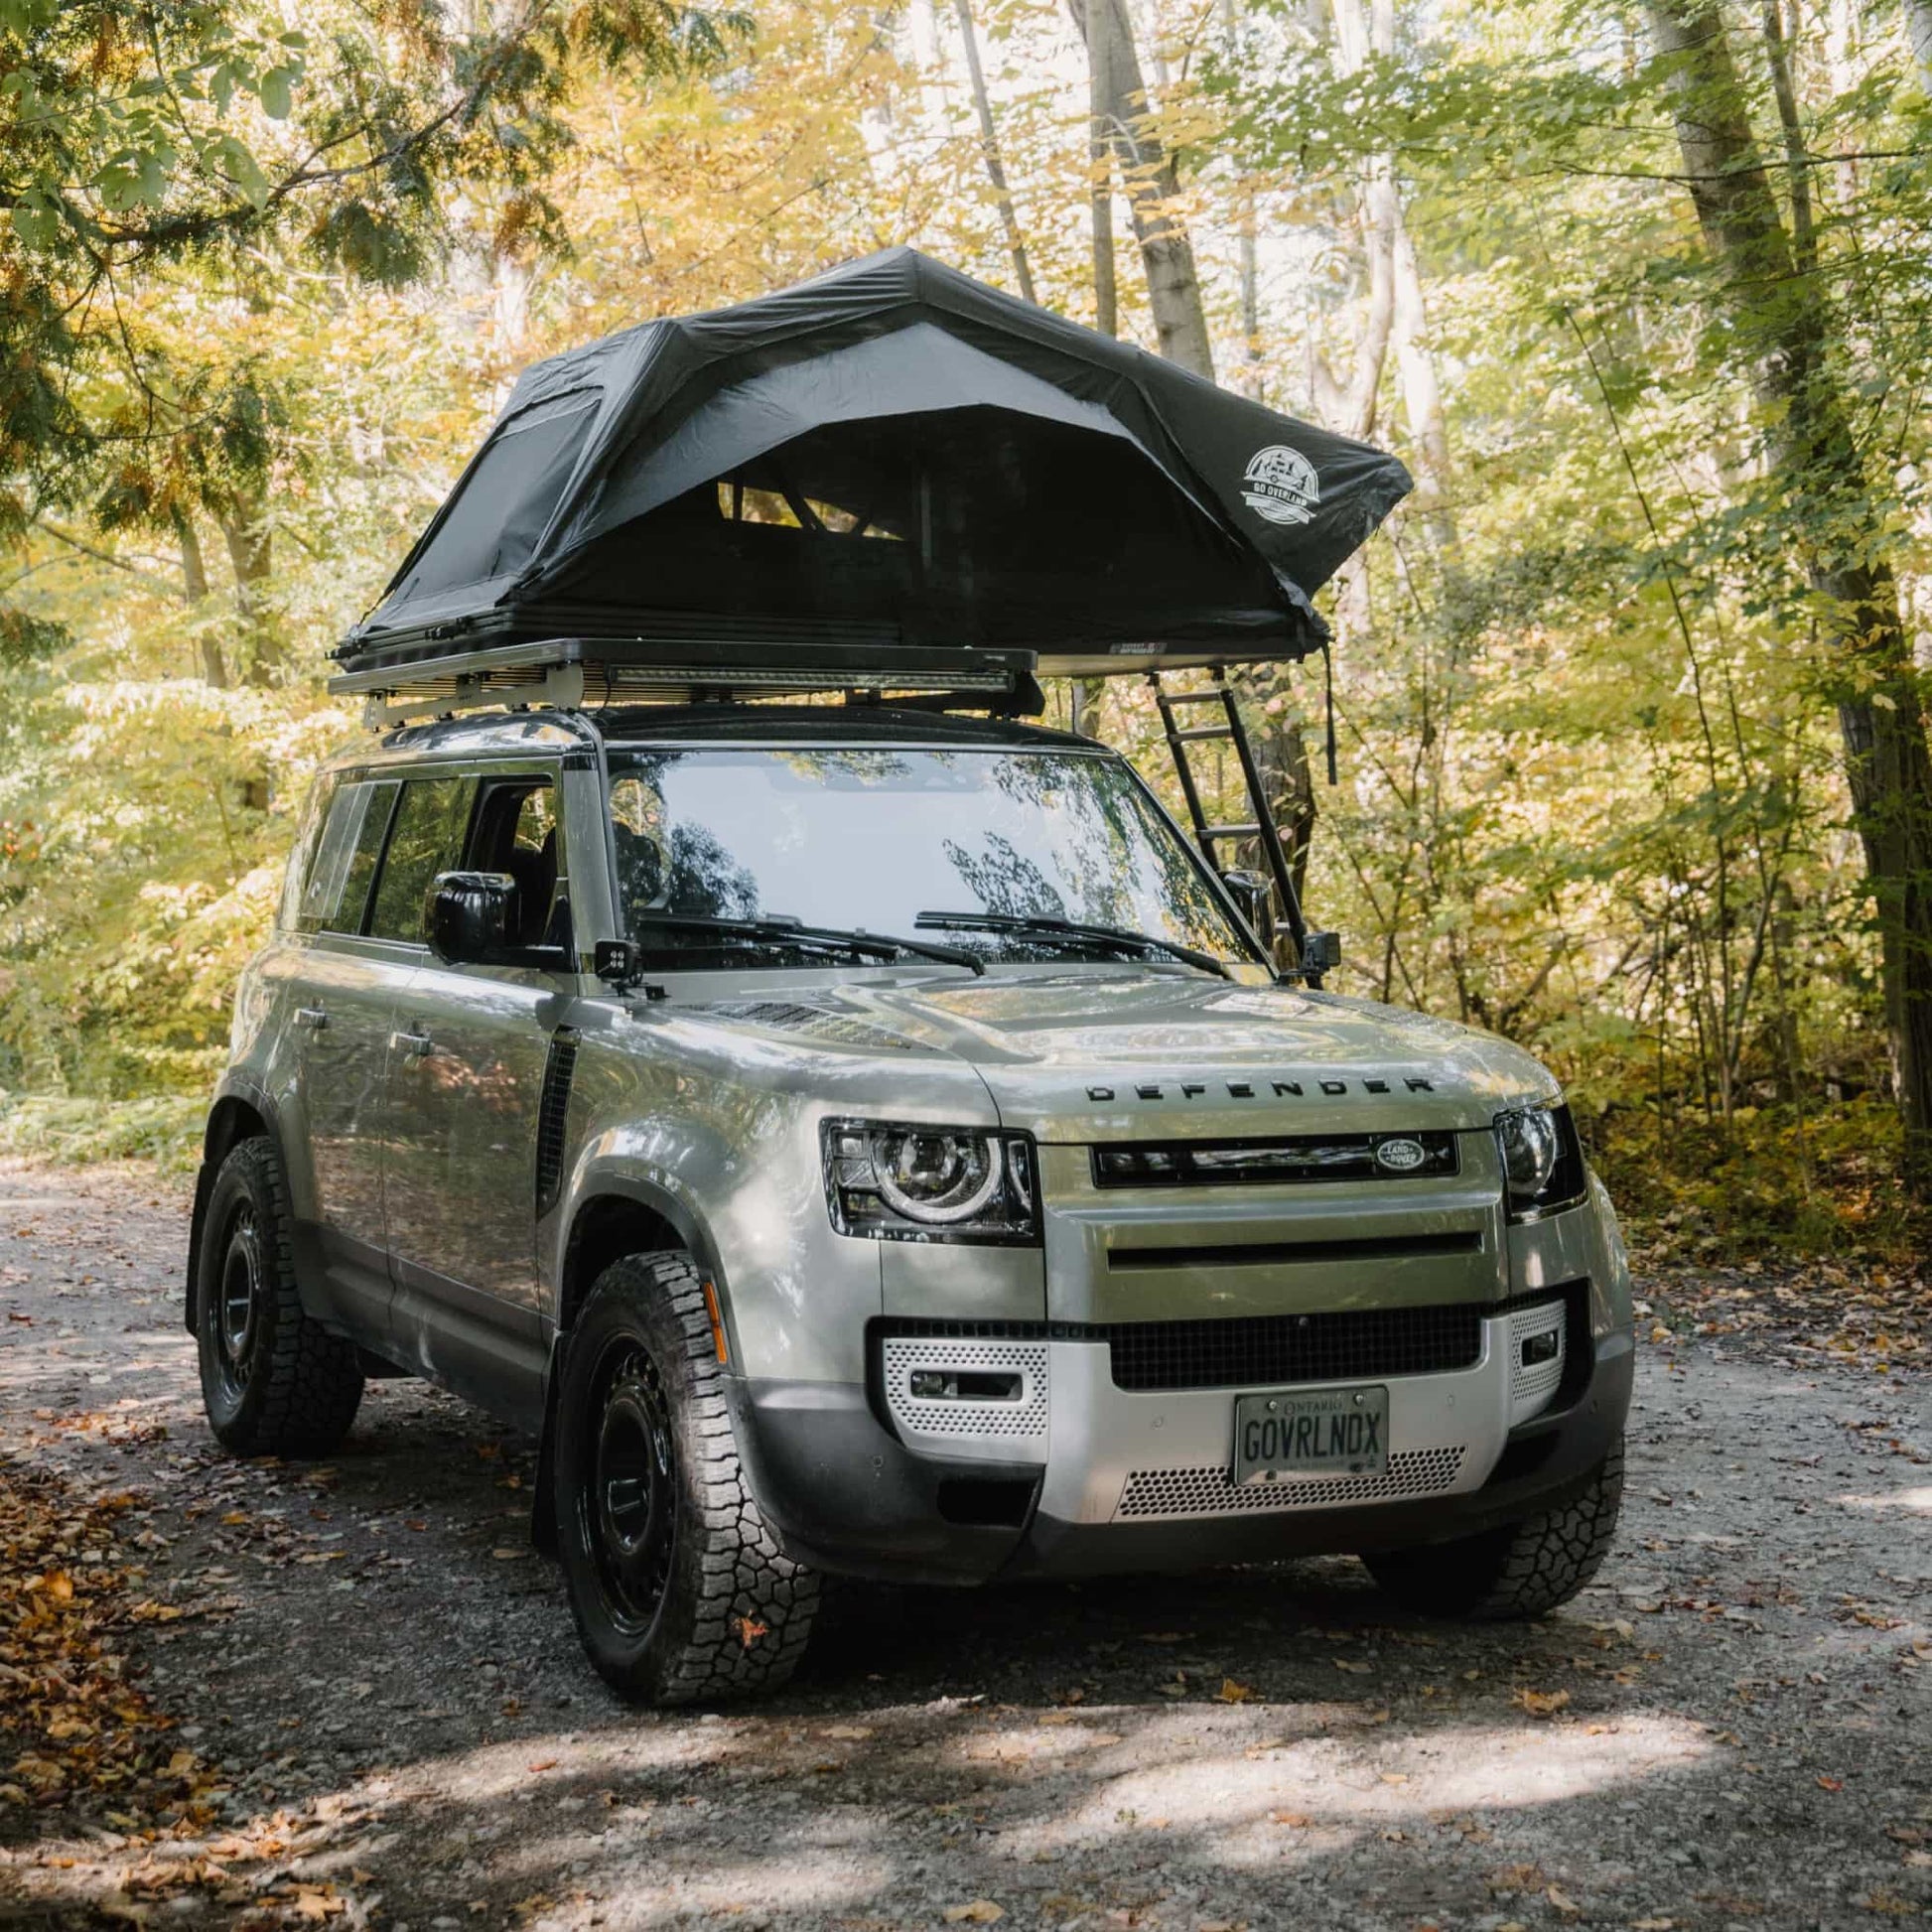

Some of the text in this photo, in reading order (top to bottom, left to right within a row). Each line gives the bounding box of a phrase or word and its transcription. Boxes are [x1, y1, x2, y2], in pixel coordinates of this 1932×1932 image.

[1253, 483, 1308, 507] GO OVERLAND
[1085, 1076, 1435, 1102] DEFENDER
[1386, 1145, 1409, 1154] LAND
[1390, 1154, 1417, 1163] ROVER
[1284, 1398, 1343, 1415] ONTARIO
[1243, 1411, 1381, 1462] GOVRLNDX
